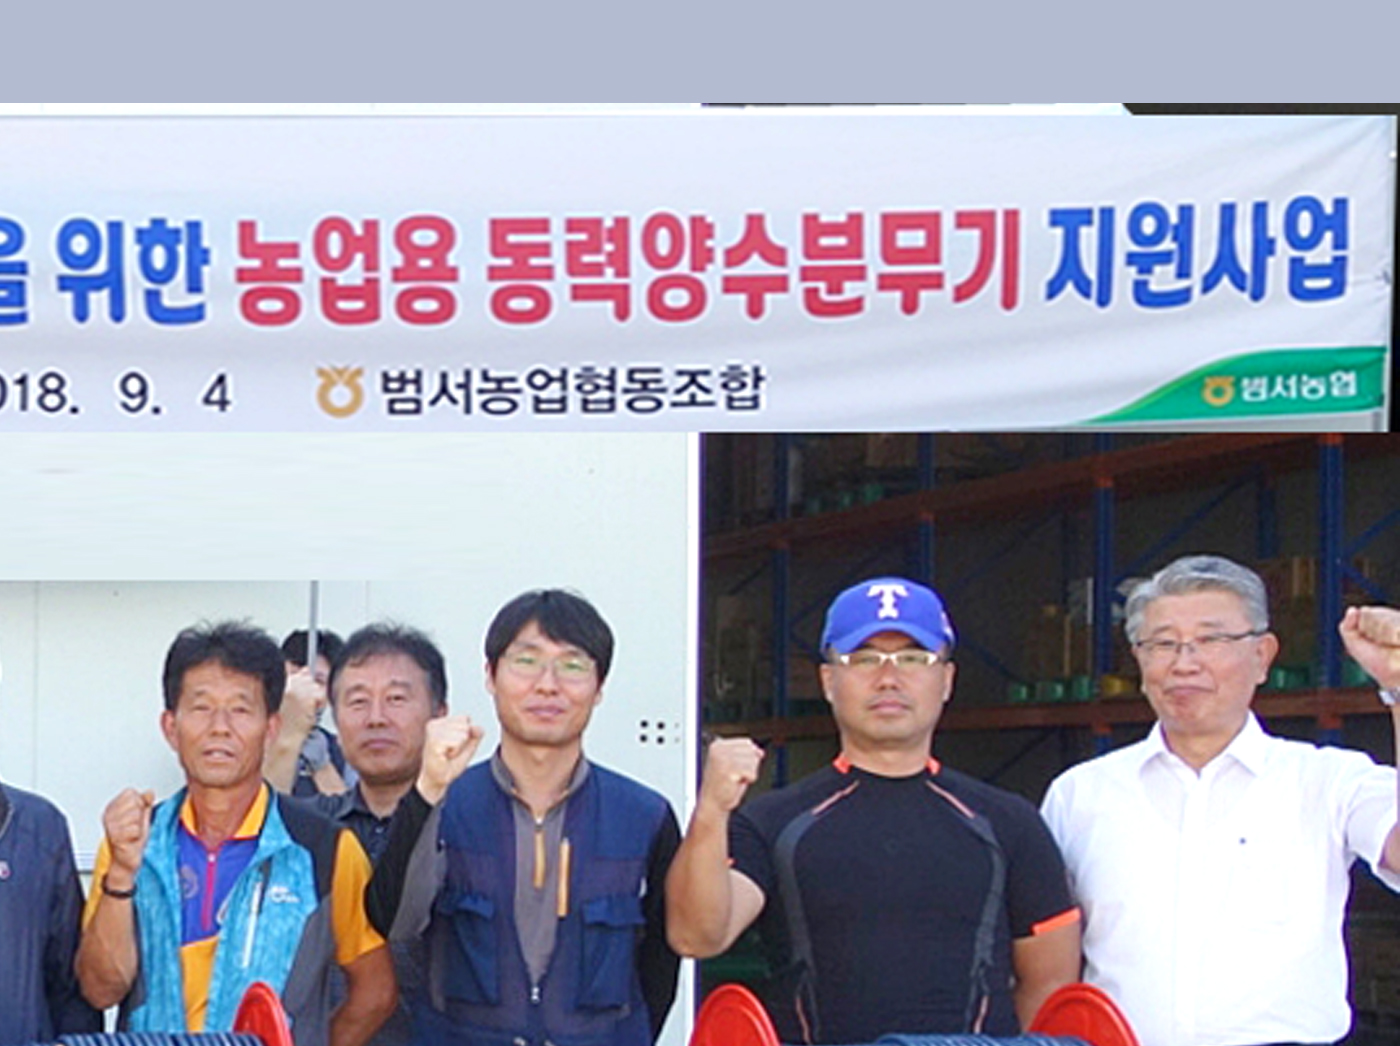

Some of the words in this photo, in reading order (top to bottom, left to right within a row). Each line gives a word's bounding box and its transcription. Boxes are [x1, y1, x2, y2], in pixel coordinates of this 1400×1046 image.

[56, 216, 211, 325] 위한
[234, 214, 460, 326] 농업용
[486, 207, 1021, 323] 동력양수분무기
[1045, 195, 1350, 309] 지원사업
[119, 371, 162, 415] 9.
[201, 371, 231, 413] 4
[381, 365, 766, 416] 범서농업협동조합
[866, 584, 909, 619] T
